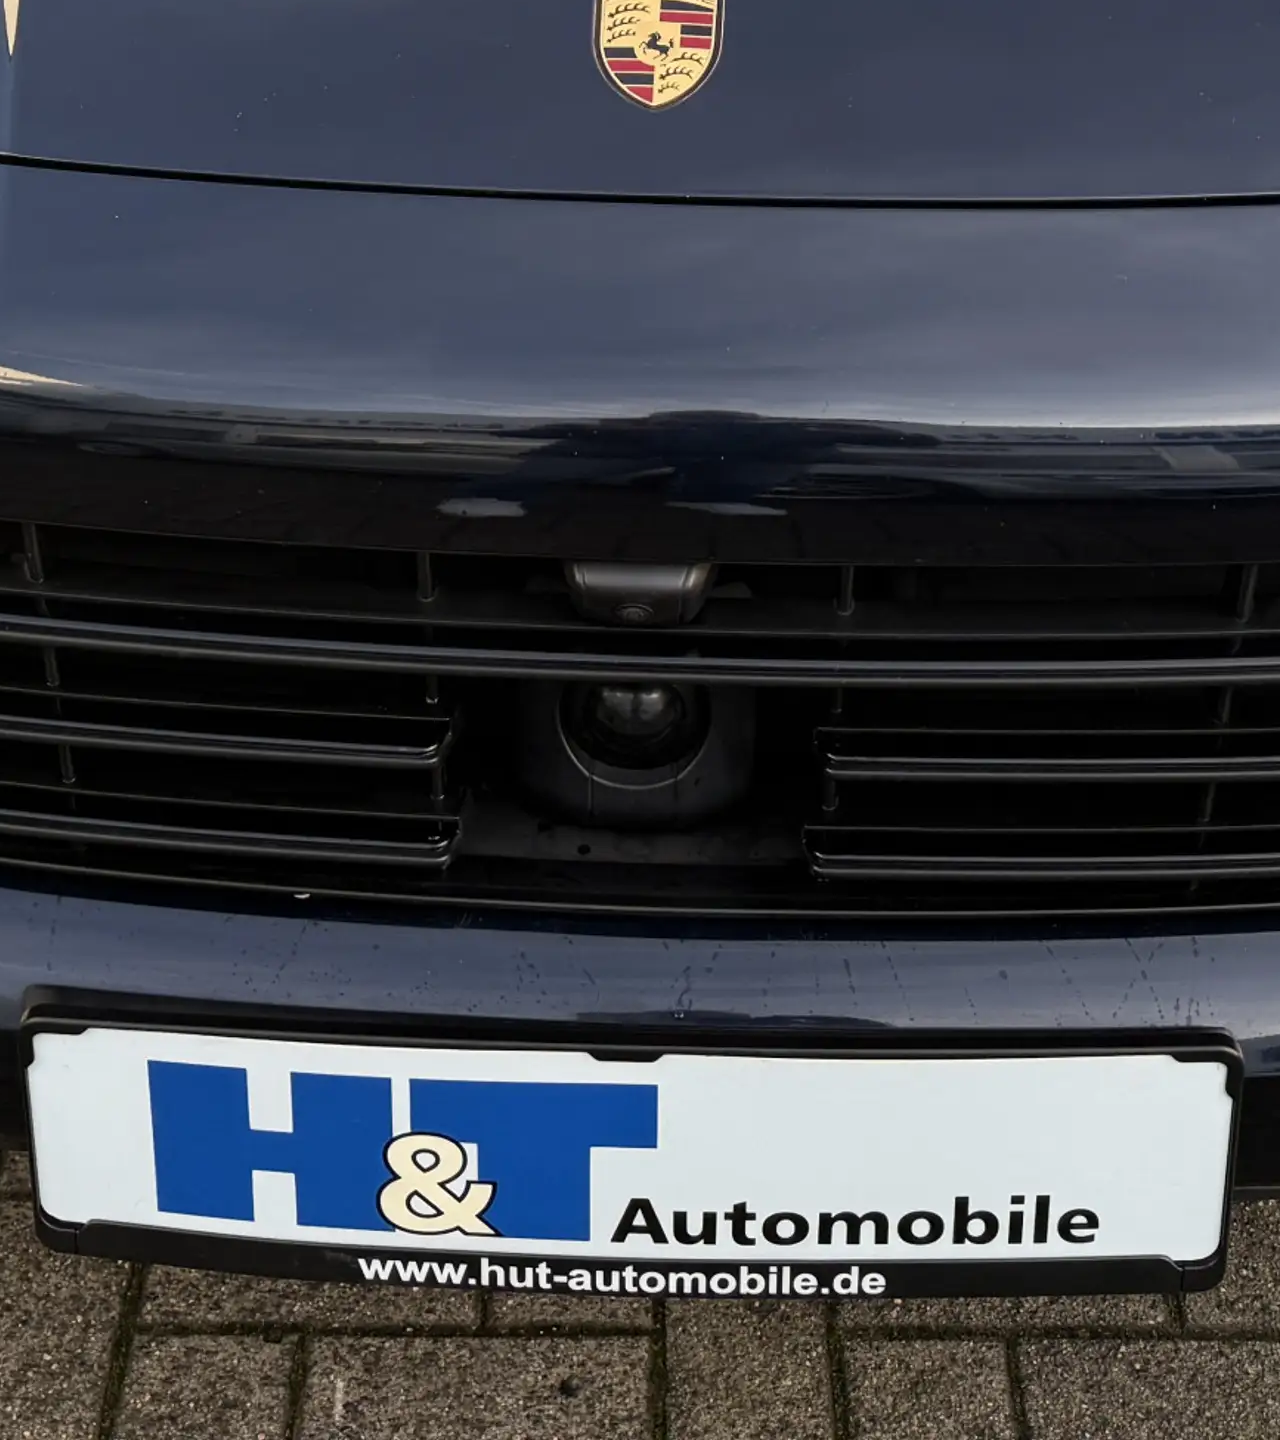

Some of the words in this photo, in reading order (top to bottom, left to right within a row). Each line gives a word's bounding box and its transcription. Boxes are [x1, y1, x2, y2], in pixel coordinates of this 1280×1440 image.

[147, 1060, 658, 1242] H&T
[611, 1195, 1100, 1246] Automobile
[359, 1258, 886, 1296] www.hut-automobile.de
